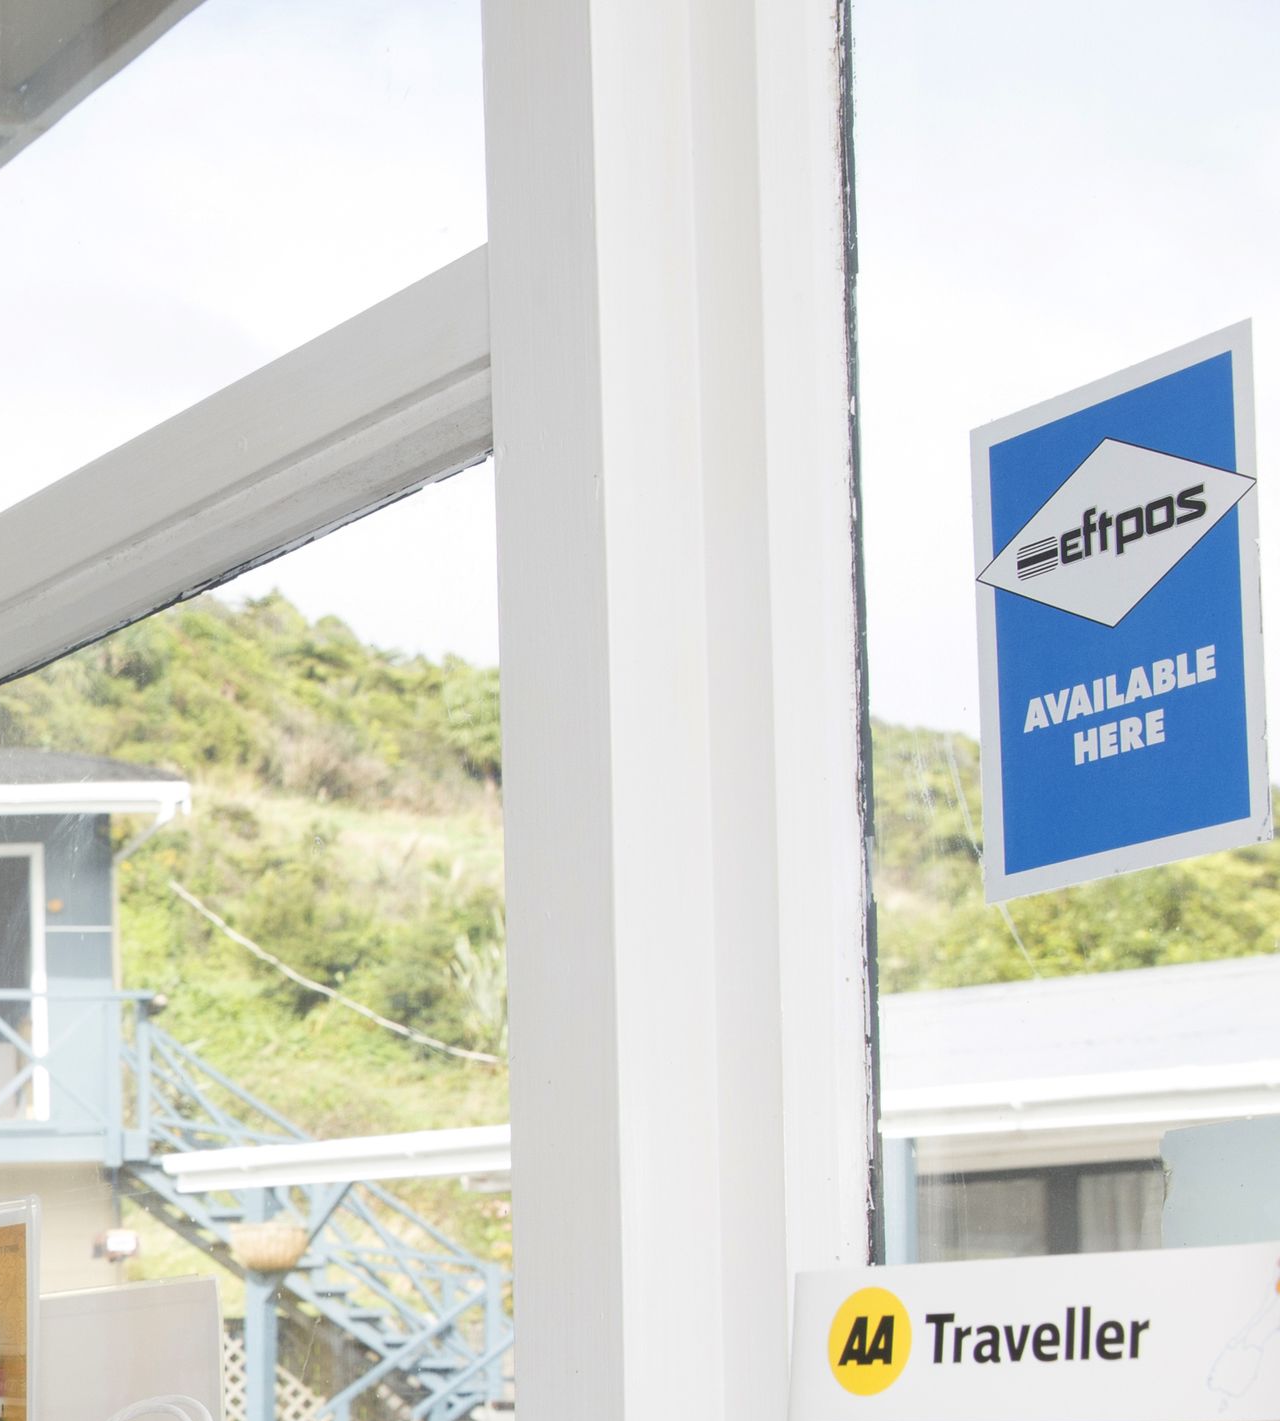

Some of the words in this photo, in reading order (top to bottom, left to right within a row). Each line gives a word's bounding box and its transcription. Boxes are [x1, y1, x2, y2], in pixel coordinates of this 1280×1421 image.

[1060, 483, 1207, 565] eftpos
[1023, 644, 1216, 734] AVAILABLE
[1074, 709, 1165, 765] HERE
[925, 1306, 1150, 1366] Traveller
